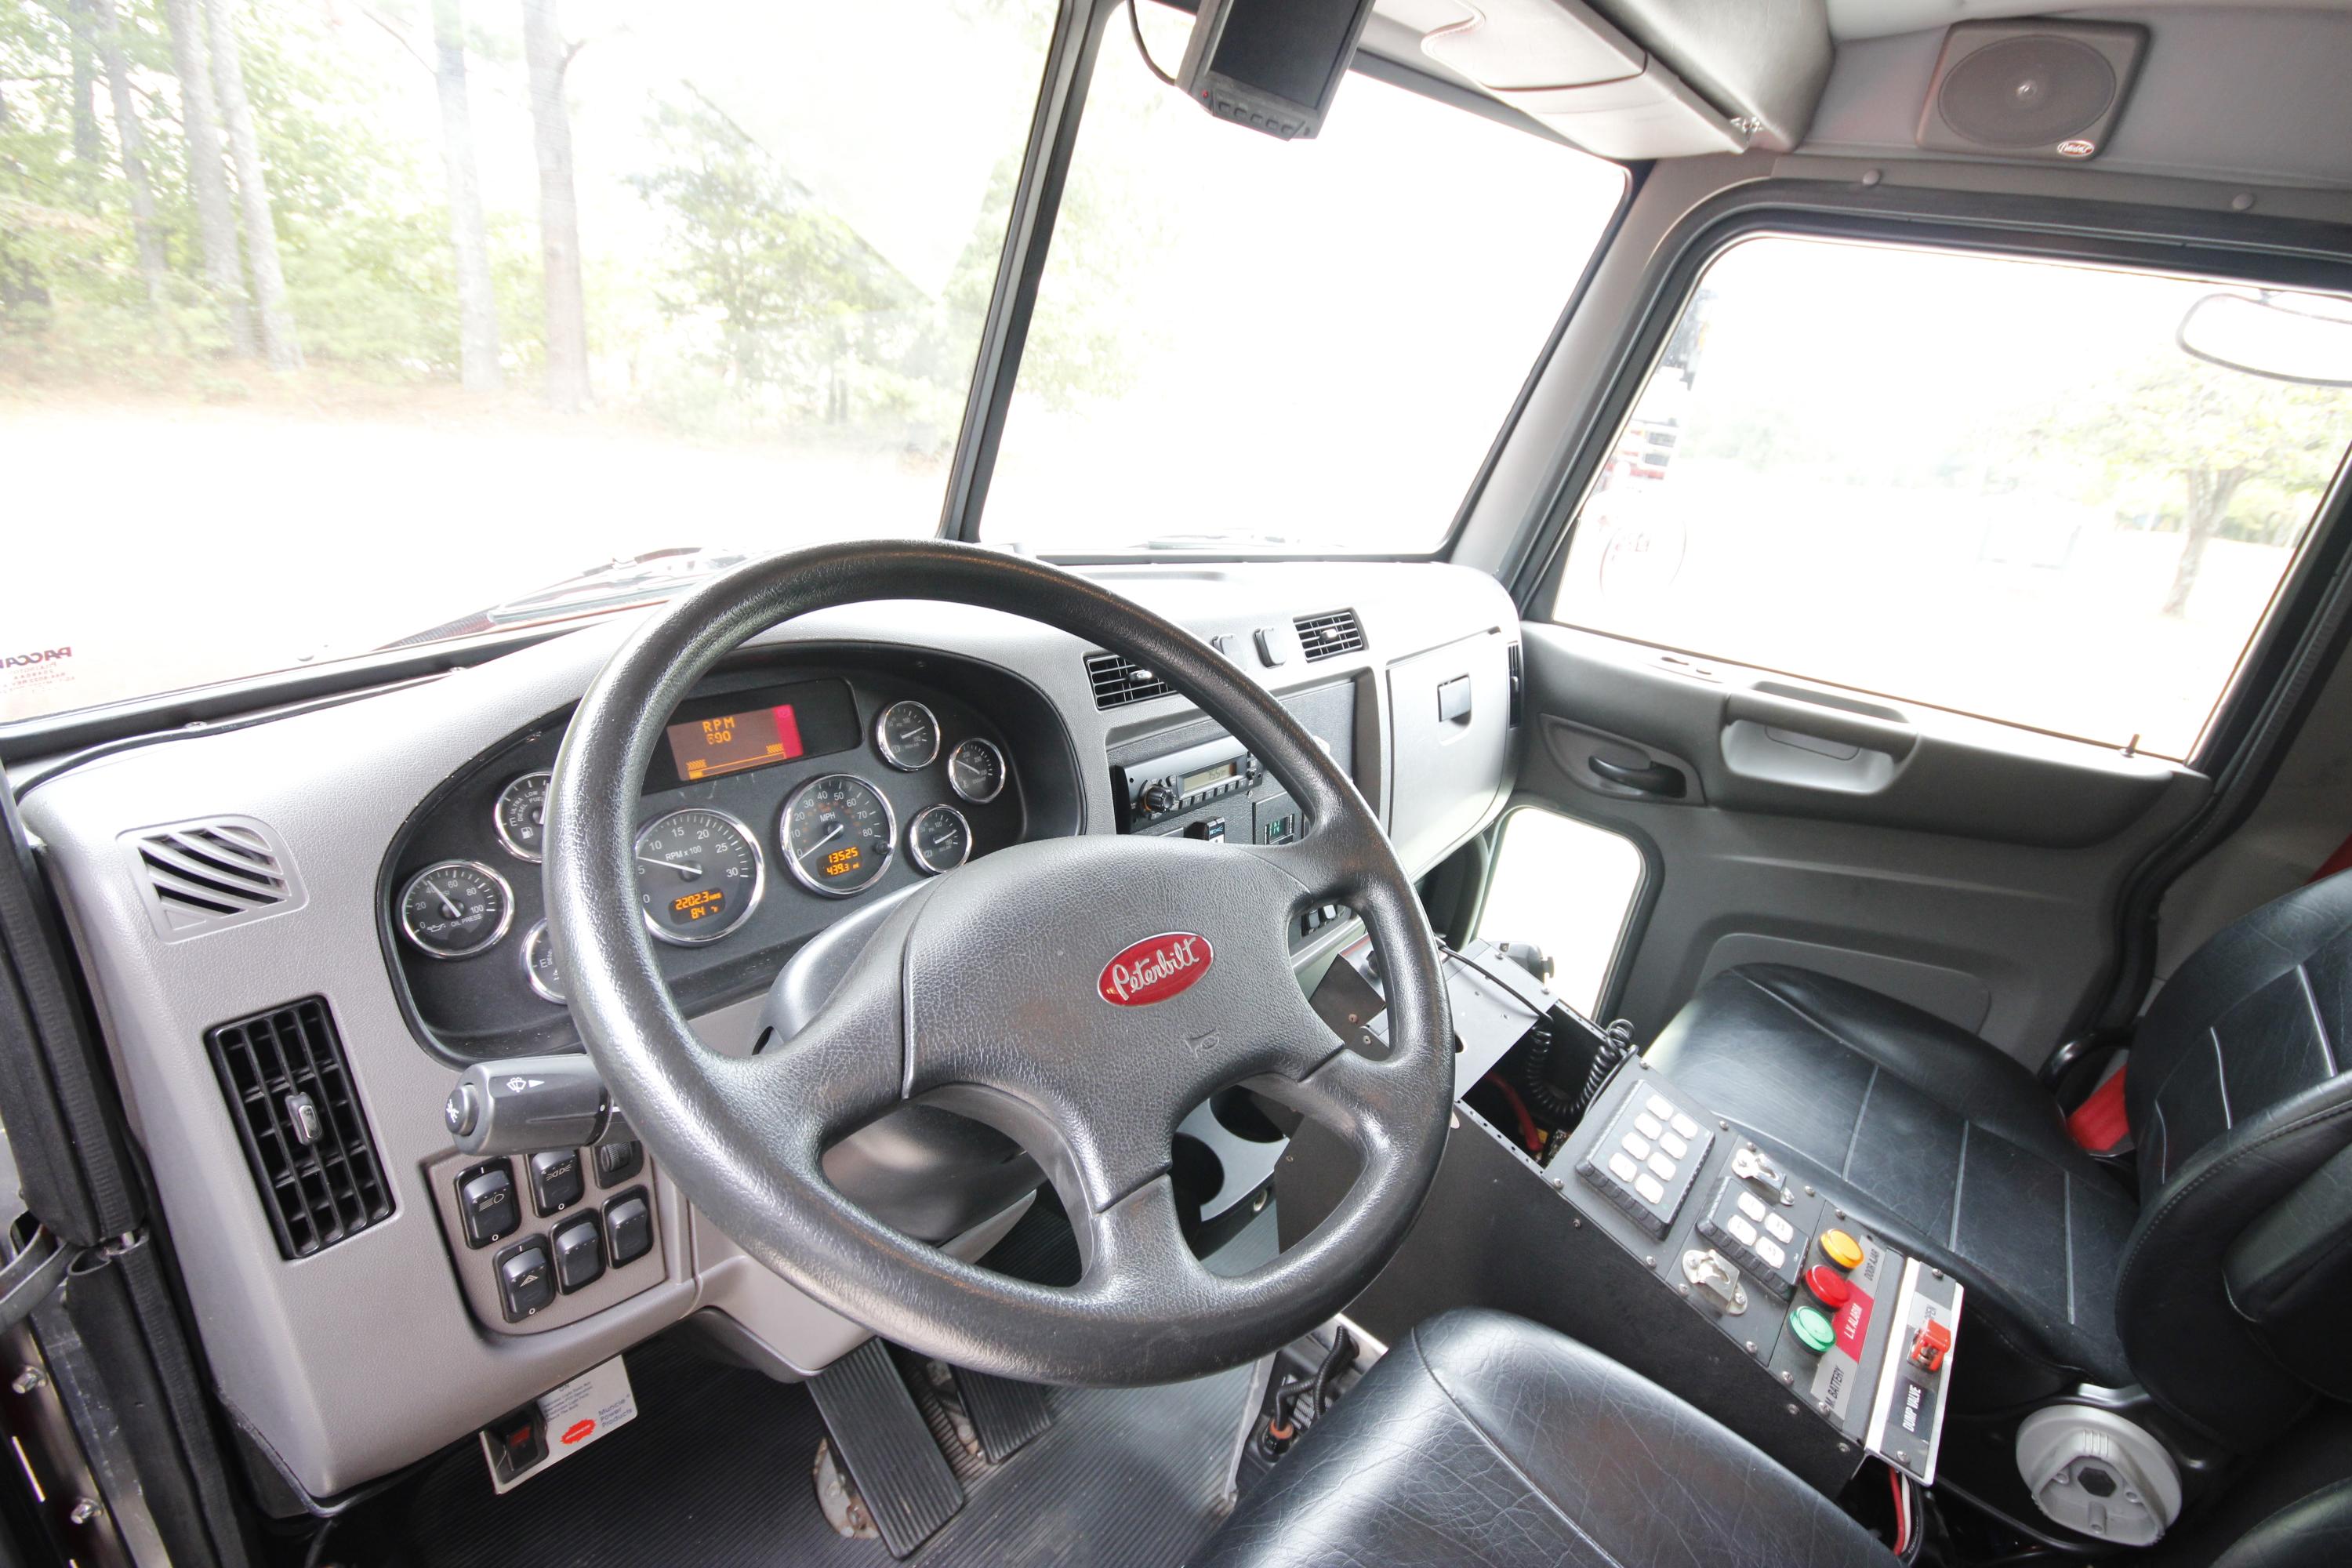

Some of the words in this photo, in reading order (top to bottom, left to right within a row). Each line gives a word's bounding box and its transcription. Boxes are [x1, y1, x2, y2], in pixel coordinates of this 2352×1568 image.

[702, 717, 735, 733] RPM
[817, 791, 828, 800] 40
[833, 792, 844, 801] 50
[803, 799, 814, 808] 30
[846, 798, 857, 808] 60
[794, 811, 805, 822] 20
[819, 811, 836, 822] MPH
[857, 811, 867, 819] 70
[671, 827, 684, 837] 15
[696, 829, 710, 840] 20
[791, 829, 800, 839] 10
[862, 828, 873, 837] 80
[649, 840, 662, 851] 10
[716, 843, 728, 853] 25
[665, 851, 683, 862] RPM
[689, 845, 702, 854] 100
[828, 847, 858, 863] 13525
[638, 866, 645, 875] 5
[726, 867, 739, 878] 30
[826, 863, 849, 876] 439.3
[448, 880, 459, 888] 60
[466, 887, 477, 896] 80
[643, 895, 650, 903] 0
[675, 891, 710, 910] 2202.3
[416, 902, 426, 910] 20
[470, 904, 484, 913] 100
[462, 913, 482, 924] PRESS
[691, 906, 706, 920] 84
[1112, 937, 1200, 1001] Peterbilt
[1864, 1261, 1875, 1282] DOOR
[1870, 1248, 1880, 1264] AJAR
[1848, 1302, 1863, 1327] ALARM
[1828, 1364, 1845, 1400] BATTERY
[1907, 1385, 1922, 1411] VALVE
[1903, 1406, 1916, 1432] DUMP
